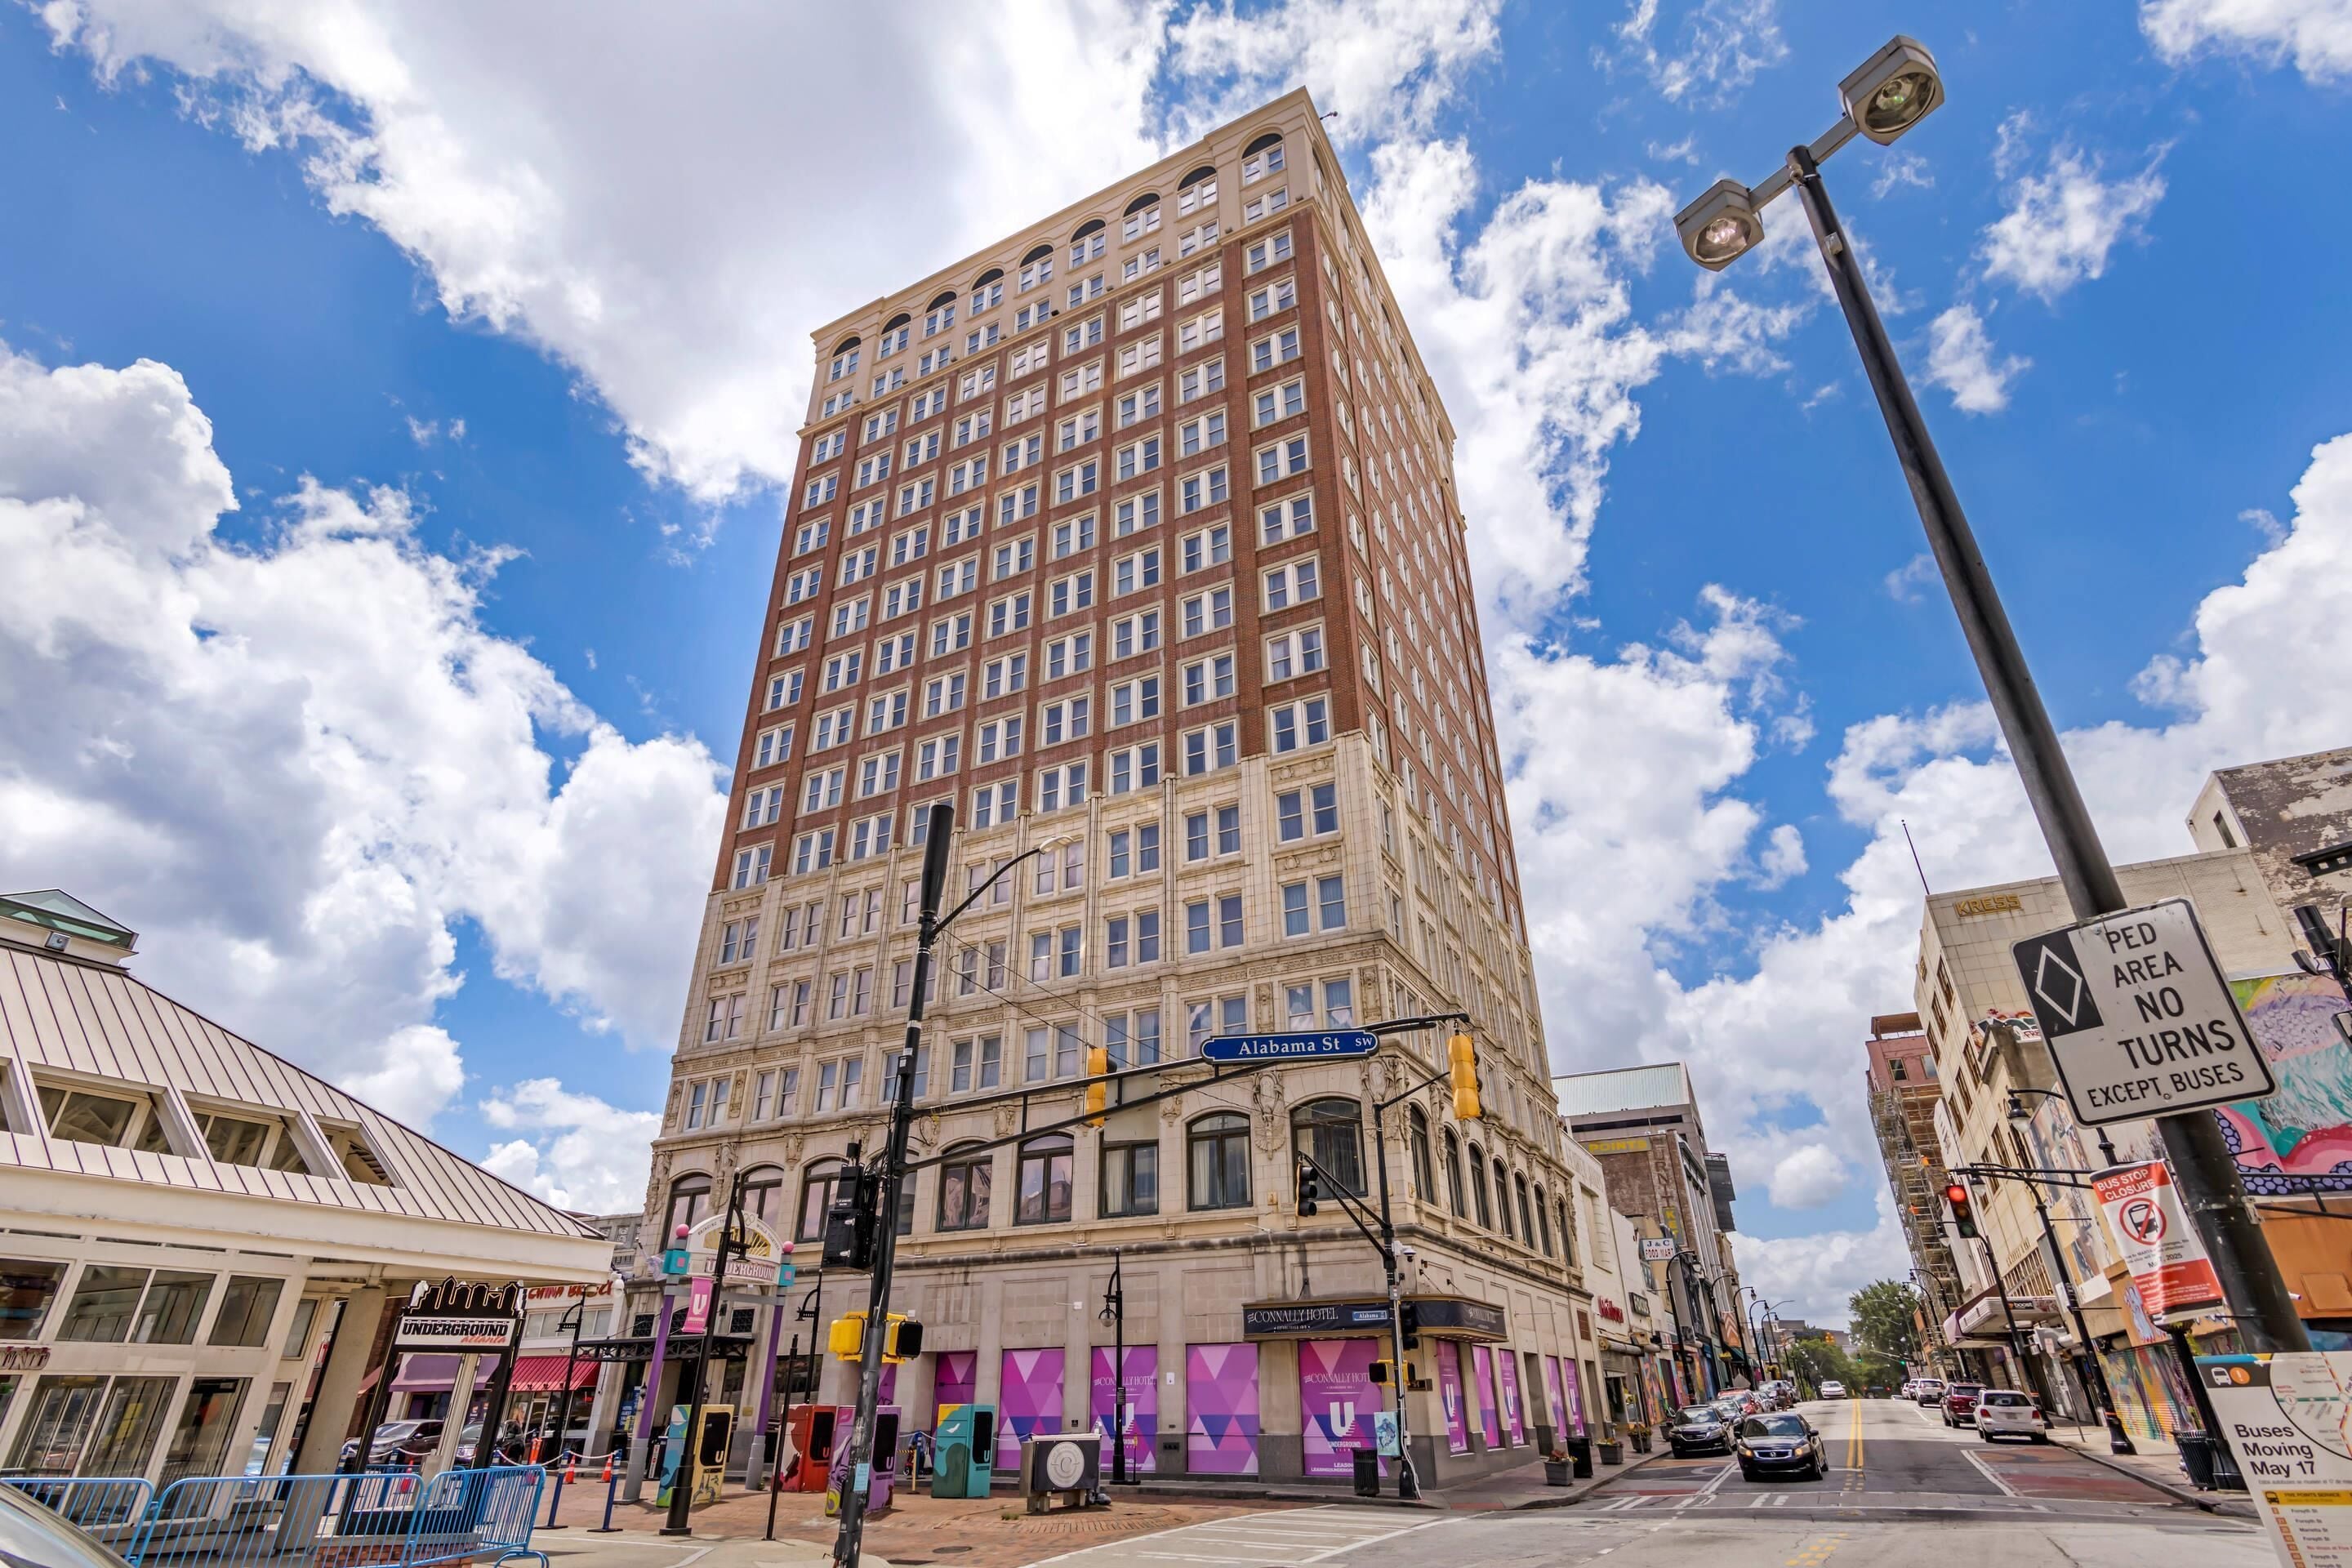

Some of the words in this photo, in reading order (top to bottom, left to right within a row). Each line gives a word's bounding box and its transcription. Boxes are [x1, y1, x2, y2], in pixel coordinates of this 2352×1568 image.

[1953, 894, 2022, 917] KRESS
[2105, 922, 2157, 954] PED
[2114, 951, 2184, 987] AREA
[2134, 987, 2184, 1022] NO
[1239, 1040, 1316, 1055] Alabama
[1322, 1037, 1340, 1050] St
[1355, 1037, 1373, 1046] SW
[2118, 1020, 2235, 1069] TURNS
[2087, 1077, 2162, 1107] EXCEPT
[2170, 1062, 2244, 1092] BUSES
[1589, 1139, 1647, 1152] POINTS
[2097, 1178, 2120, 1192] BUS
[2120, 1169, 2149, 1184] STOP
[2105, 1178, 2156, 1200] CLOSURE
[705, 1258, 776, 1281] UDERGROUND
[1254, 1309, 1305, 1323] CONNALLY
[1307, 1307, 1339, 1321] HOTEL
[402, 1322, 509, 1336] UNDERGROUND
[461, 1334, 506, 1343] atlanta
[1100, 1376, 1134, 1386] CONLLY
[1311, 1373, 1351, 1383] CONNALLY
[1352, 1373, 1370, 1383] HOT
[1330, 1401, 1356, 1437] U
[2234, 1424, 2294, 1437] Buses
[715, 1450, 724, 1463] U
[2242, 1442, 2314, 1459] Moving
[886, 1456, 894, 1469] U
[2250, 1461, 2290, 1478] May
[2296, 1461, 2314, 1475] 17
